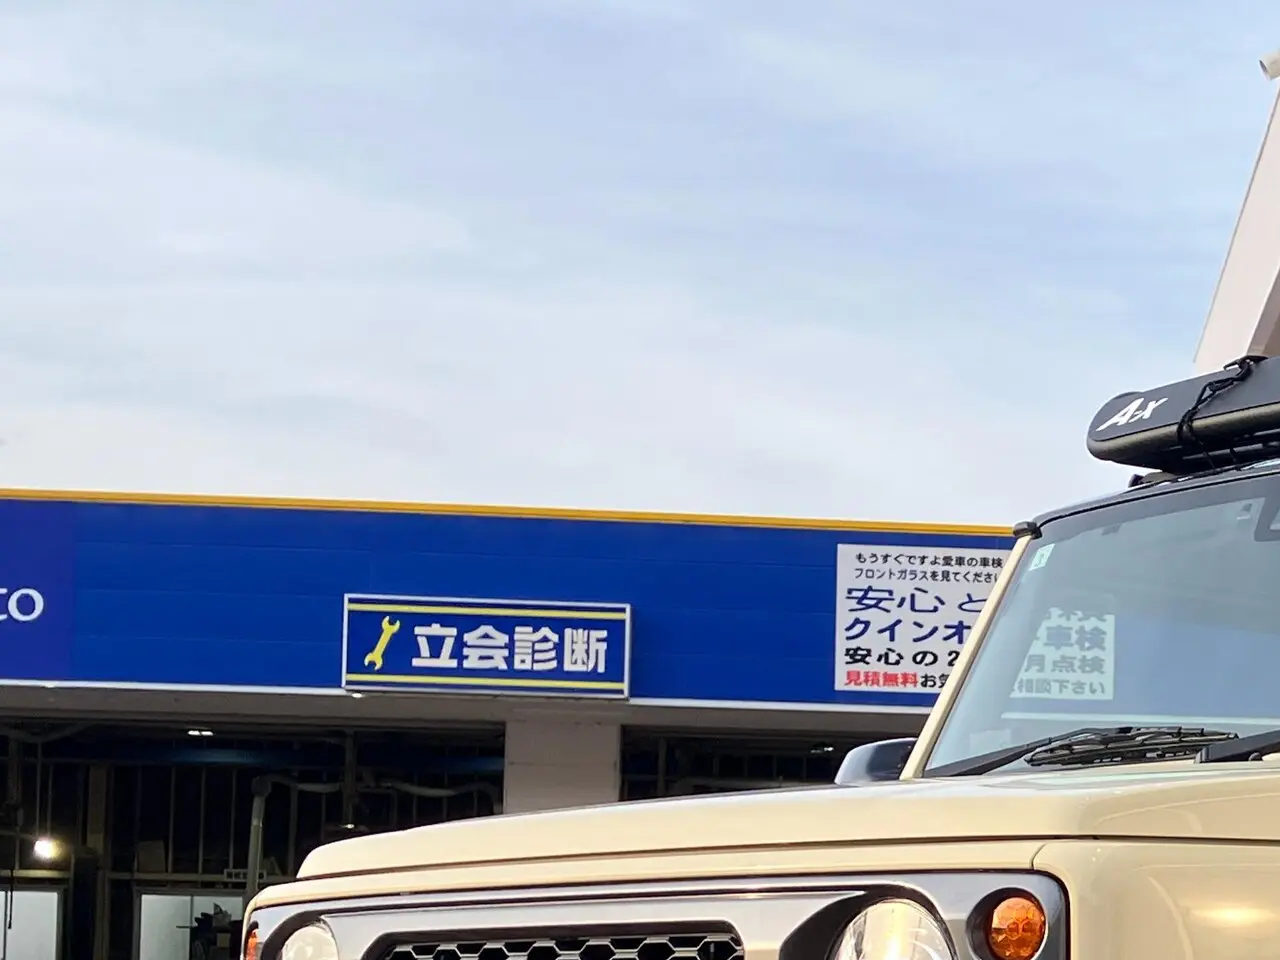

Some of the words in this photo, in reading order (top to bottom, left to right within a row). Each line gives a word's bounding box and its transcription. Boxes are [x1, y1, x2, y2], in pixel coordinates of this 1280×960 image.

[856, 553, 1003, 568] もうすぐですよ愛車の車検
[845, 585, 987, 613] 安心と
[412, 623, 608, 673] 立会診断
[844, 617, 971, 644] クインオ
[1043, 624, 1107, 651] 車検
